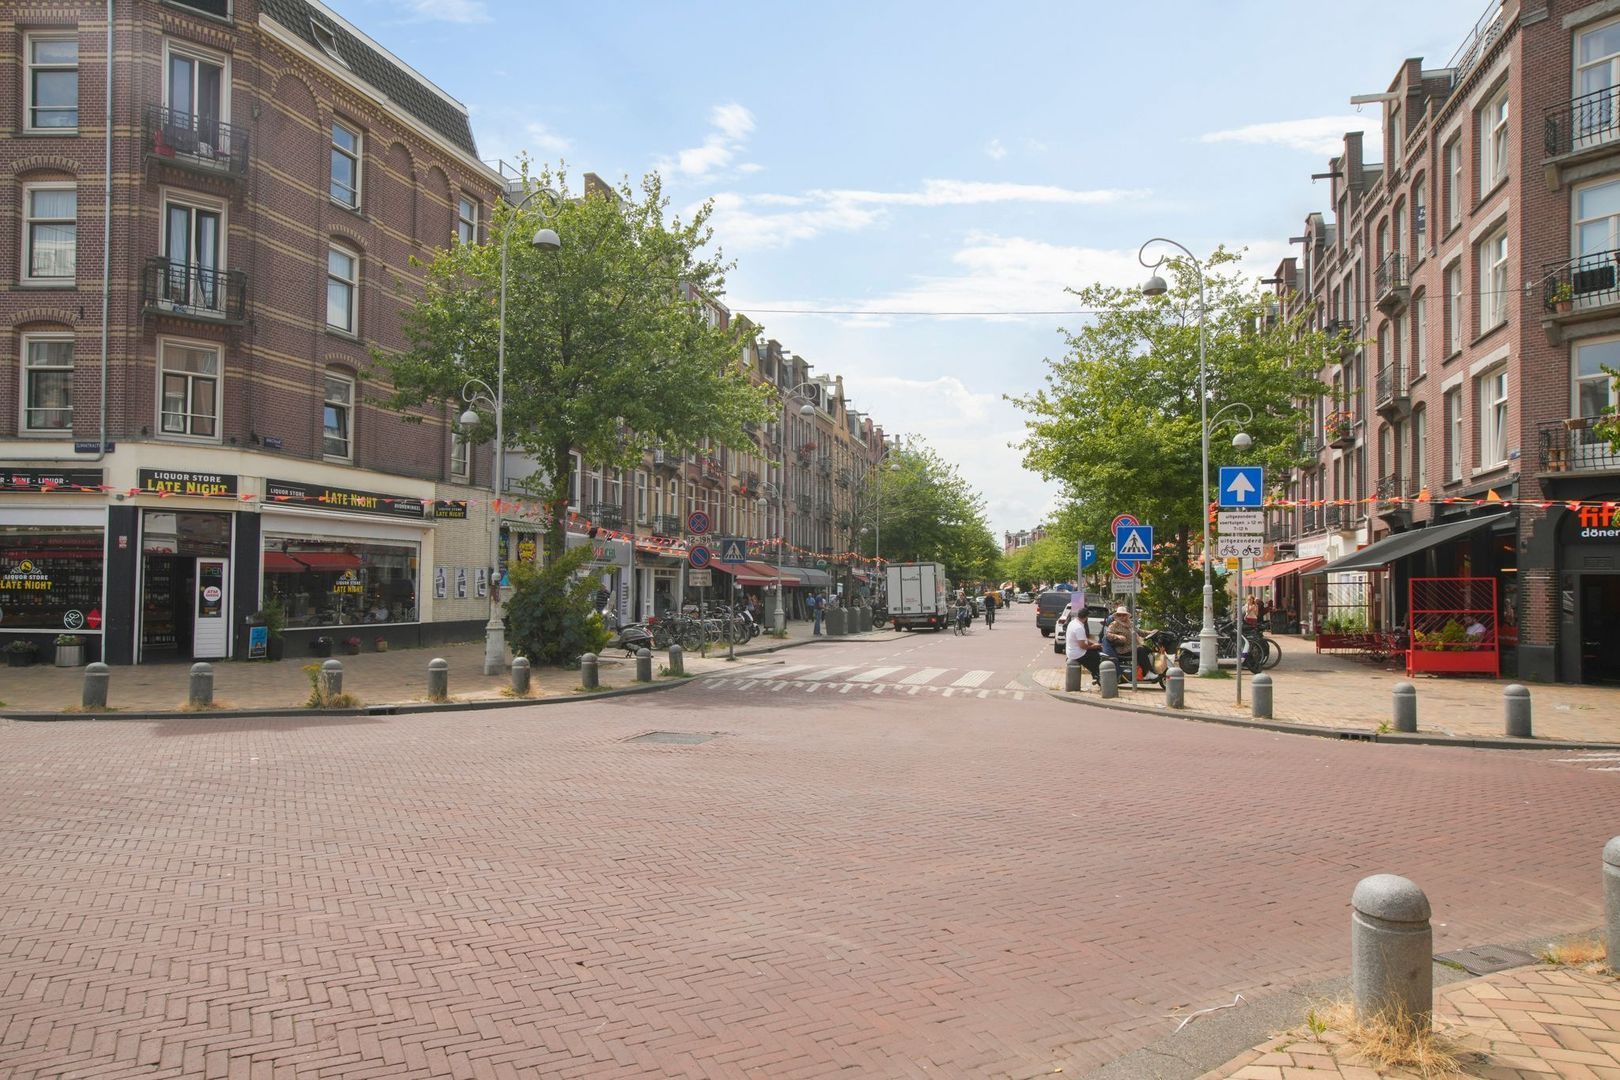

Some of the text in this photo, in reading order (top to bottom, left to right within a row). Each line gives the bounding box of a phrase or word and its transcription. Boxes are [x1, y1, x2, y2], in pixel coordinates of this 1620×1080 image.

[154, 472, 221, 483] LIQUOR STORE
[147, 479, 227, 495] LATE NIGHT
[325, 490, 348, 505] LATE
[1085, 551, 1092, 560] P
[0, 580, 52, 590] LATE NIGHT
